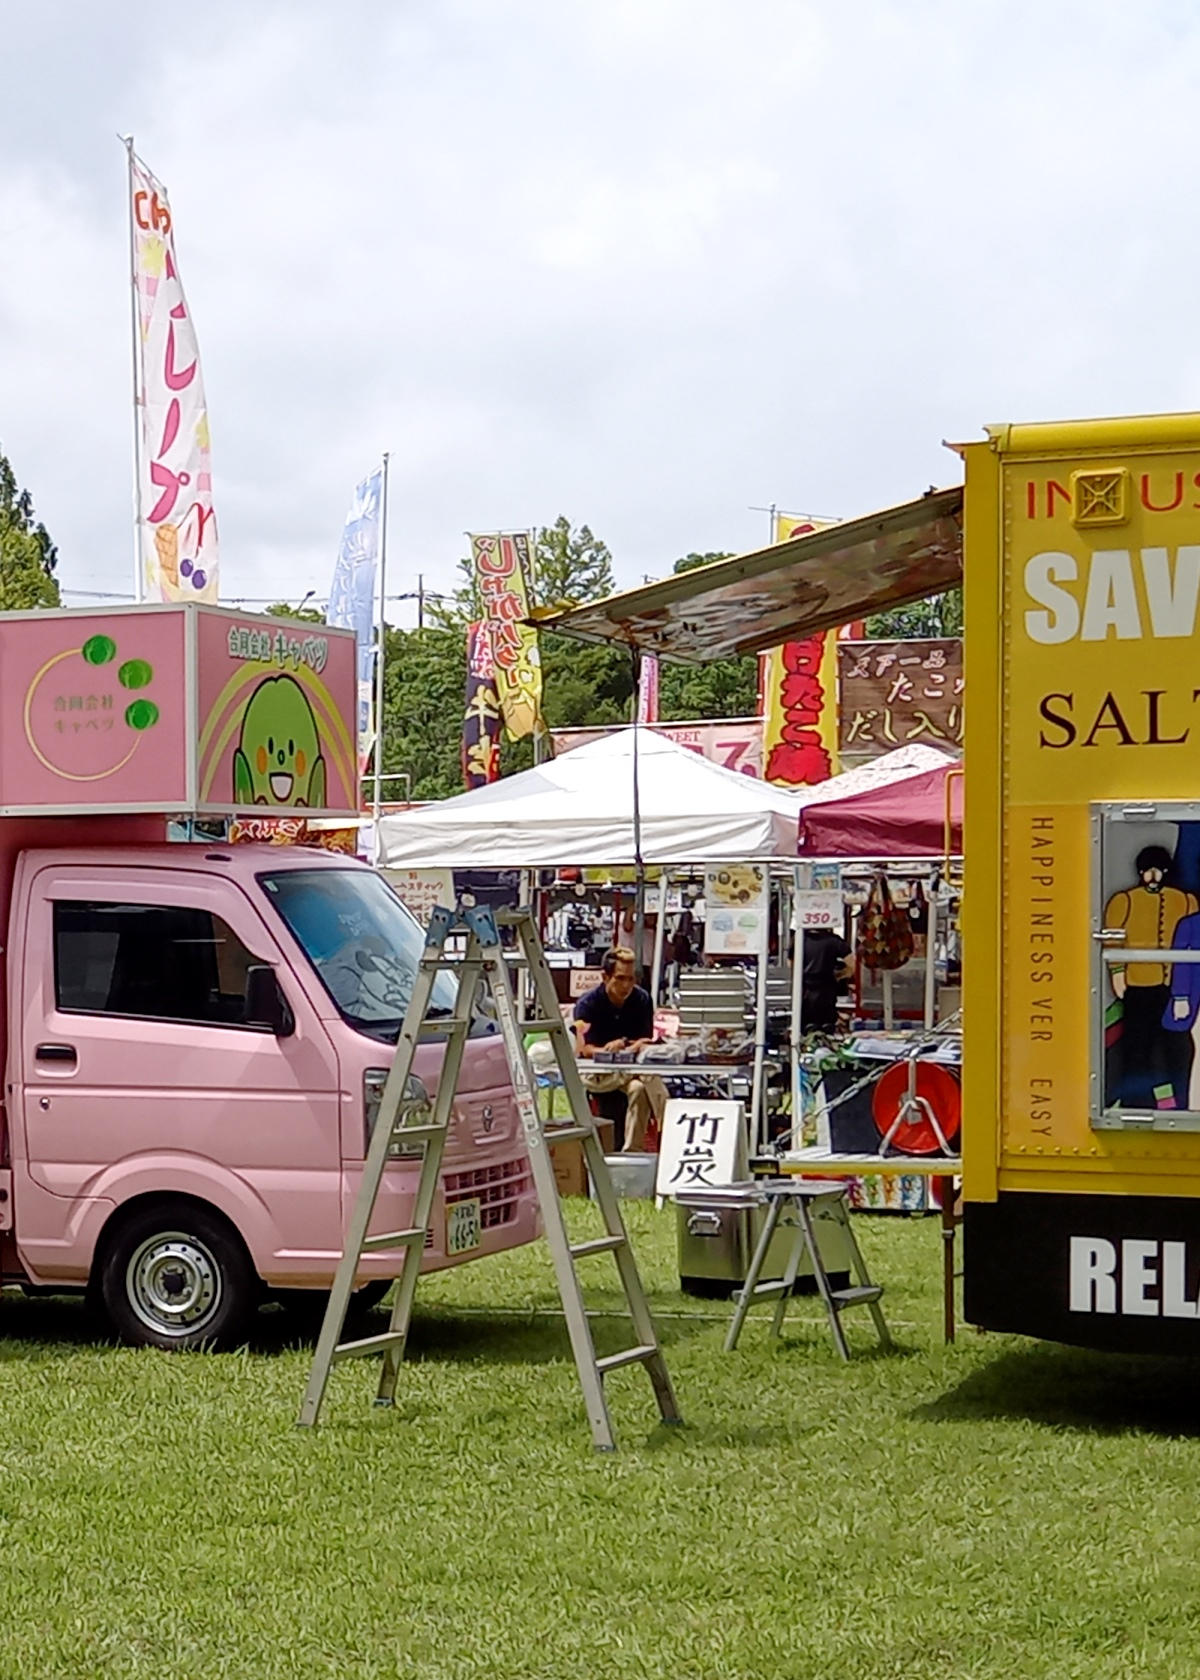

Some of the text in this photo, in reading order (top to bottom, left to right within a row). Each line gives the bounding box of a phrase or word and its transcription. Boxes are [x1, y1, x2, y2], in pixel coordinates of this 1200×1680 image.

[1027, 470, 1200, 519] INU
[274, 629, 328, 673] キャベツ
[54, 695, 114, 712] 合同会社
[54, 719, 115, 733] キャベツ
[1038, 689, 1200, 750] SAL
[663, 730, 701, 744] WEET
[1030, 817, 1054, 1138] HAPPINESS VER EASY
[669, 1112, 725, 1187] 竹炭
[1069, 1235, 1200, 1319] REL
